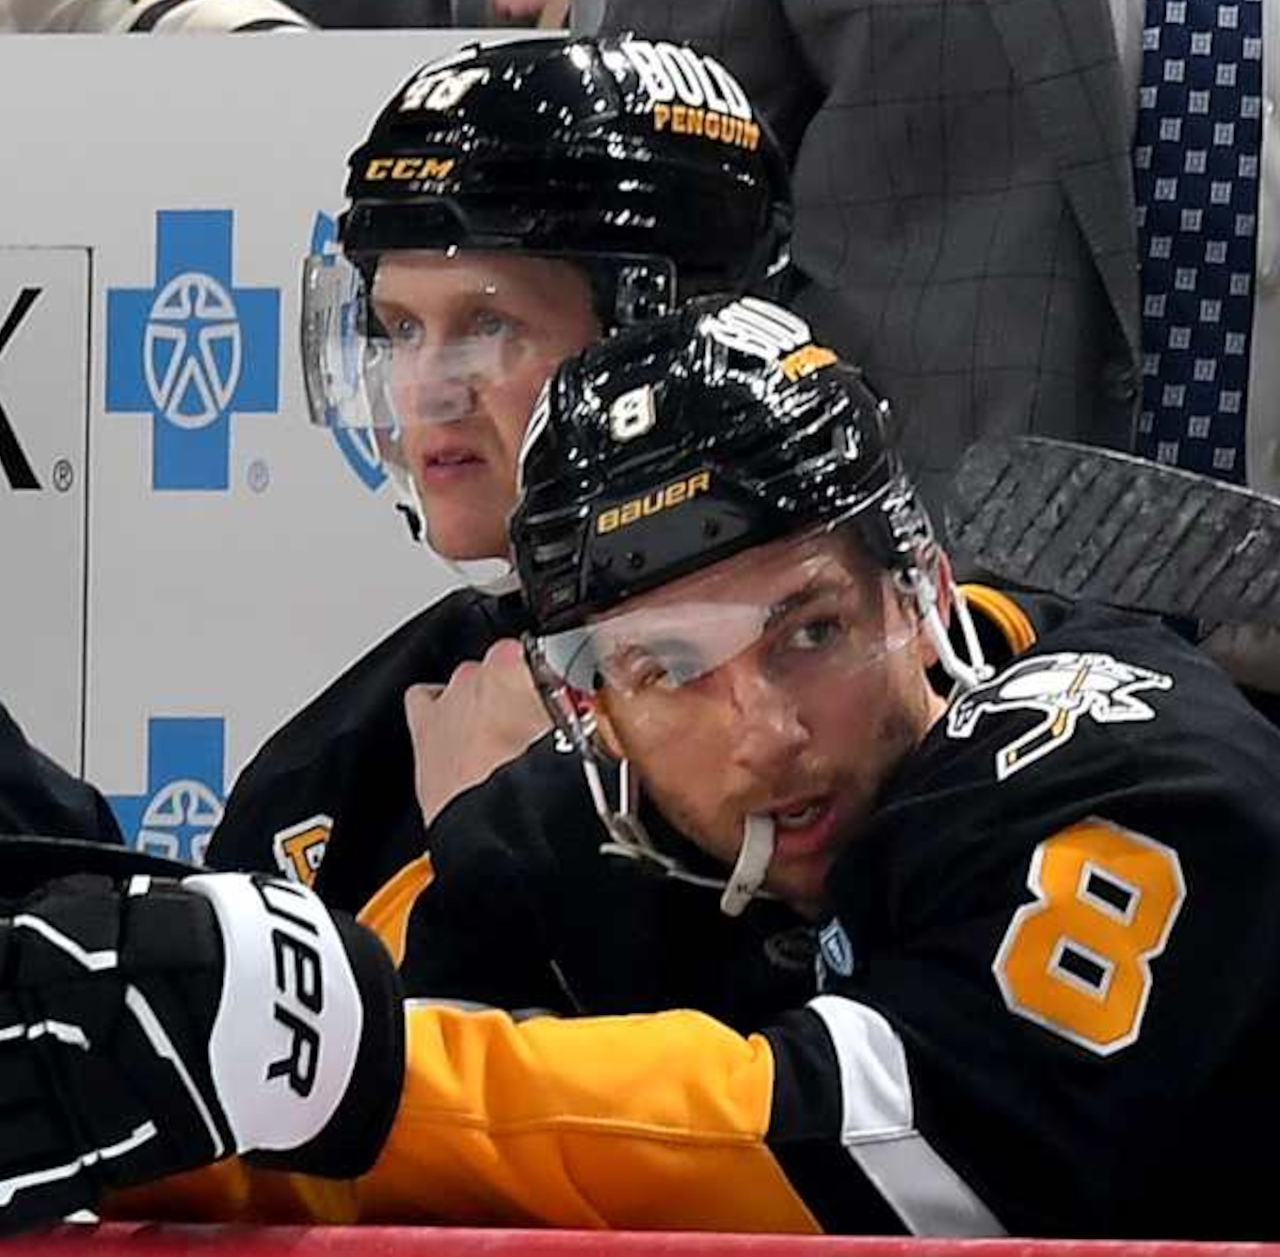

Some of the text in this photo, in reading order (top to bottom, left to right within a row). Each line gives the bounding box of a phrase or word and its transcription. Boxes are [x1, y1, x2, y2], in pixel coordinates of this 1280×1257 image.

[625, 39, 753, 121] BOLD
[653, 103, 761, 152] PENGUIN
[364, 157, 458, 181] CCM
[608, 383, 657, 441] 8
[595, 467, 712, 536] BAUER
[990, 815, 1188, 1057] 8
